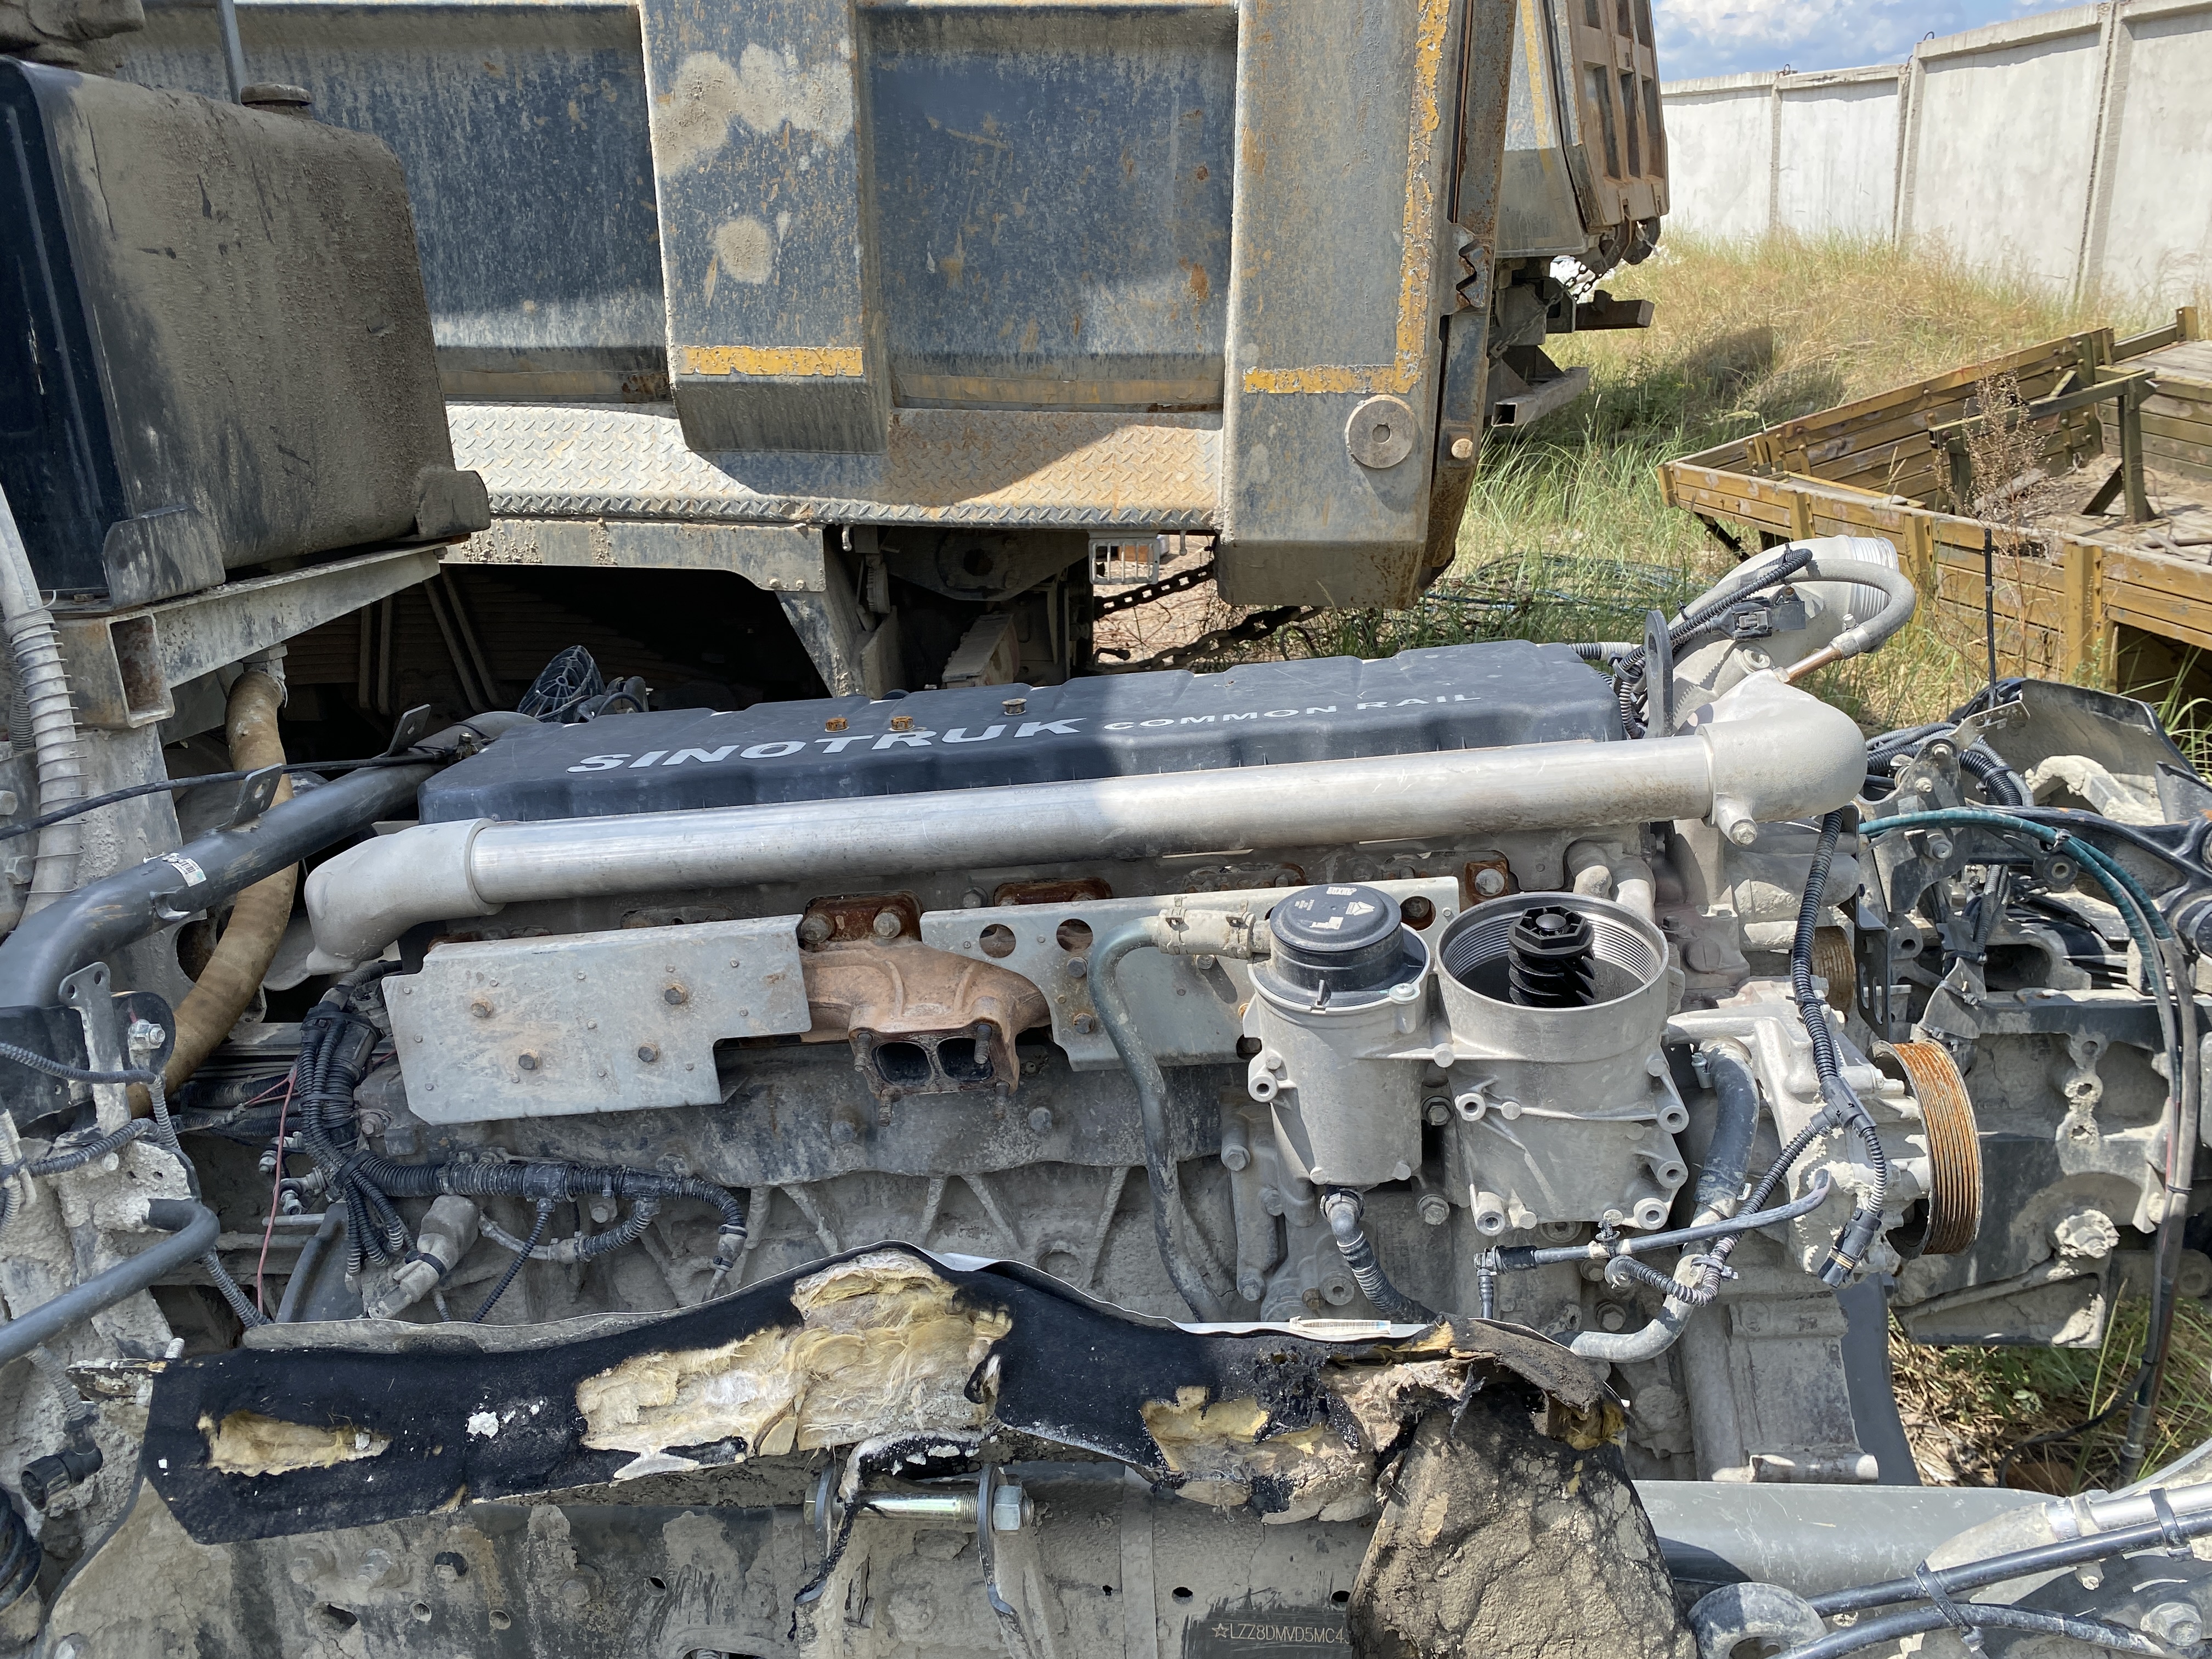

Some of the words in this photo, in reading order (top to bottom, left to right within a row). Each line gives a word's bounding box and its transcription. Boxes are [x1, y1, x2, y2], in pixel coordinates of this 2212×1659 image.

[1103, 705, 1338, 730] COMMON
[1356, 693, 1482, 711] RAIL
[566, 717, 1087, 774] SINOTRUK
